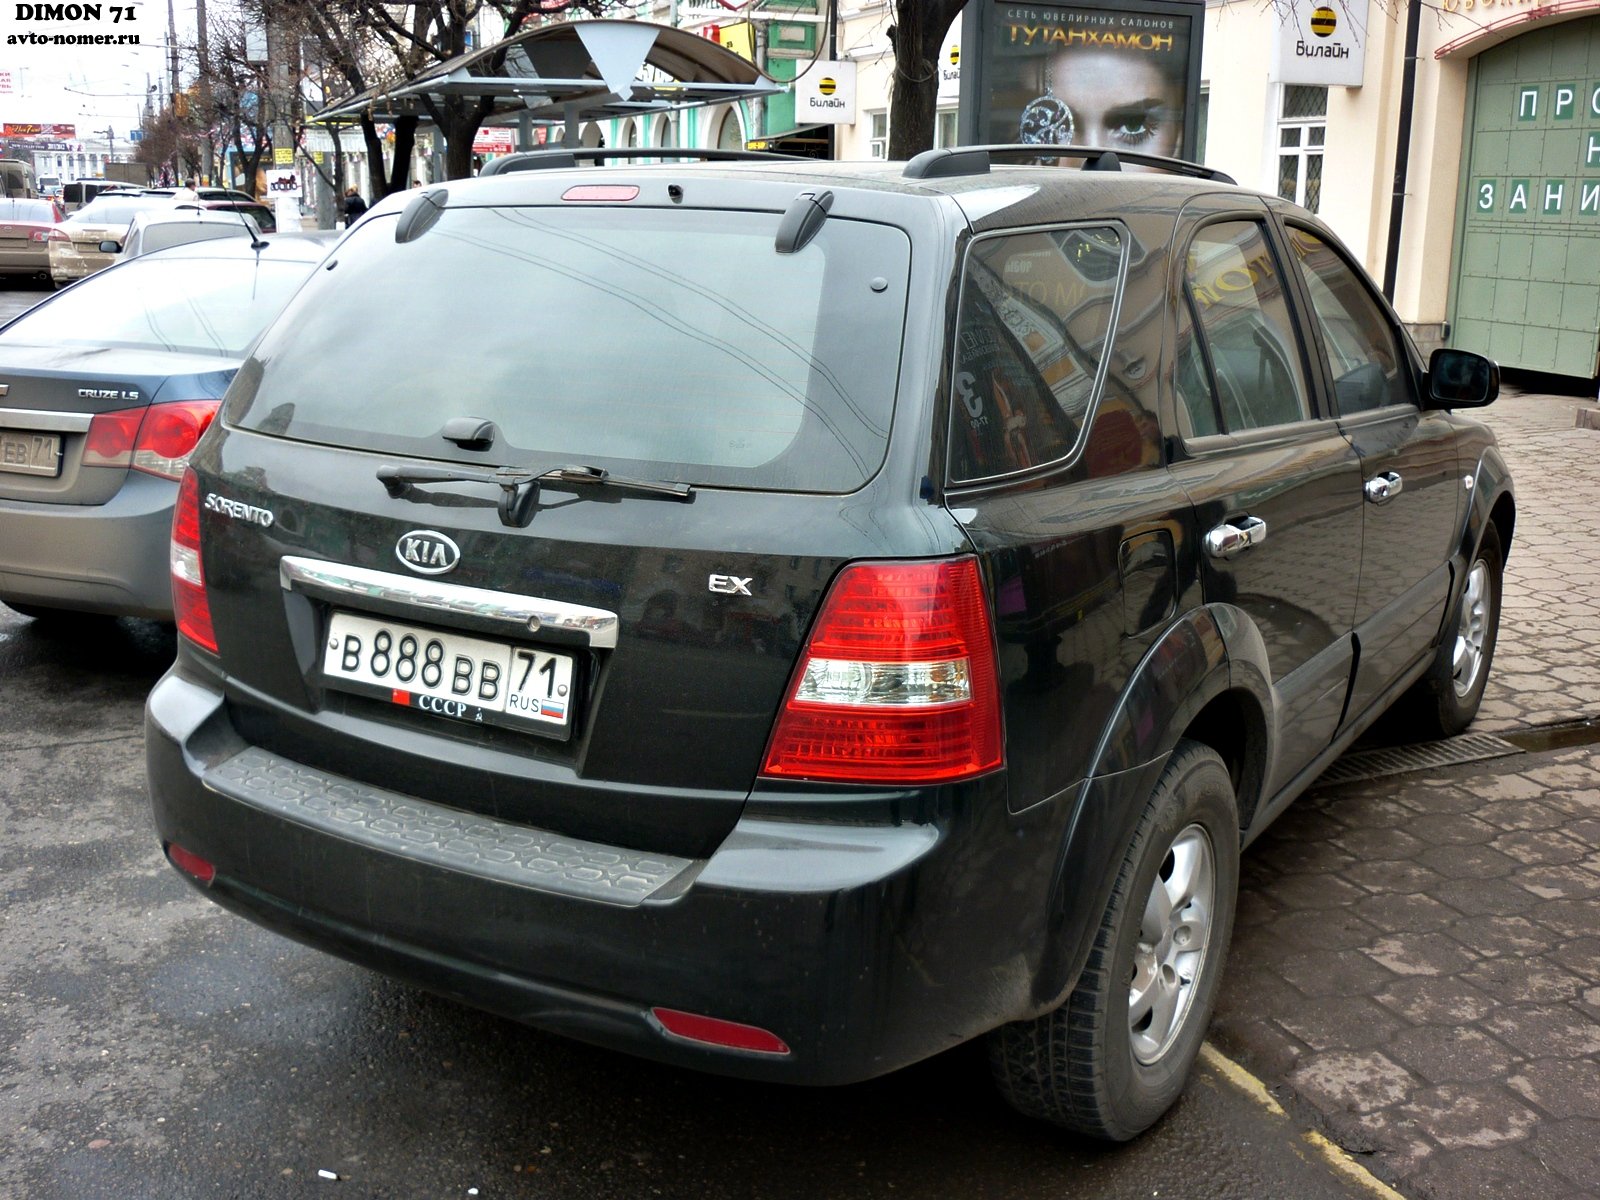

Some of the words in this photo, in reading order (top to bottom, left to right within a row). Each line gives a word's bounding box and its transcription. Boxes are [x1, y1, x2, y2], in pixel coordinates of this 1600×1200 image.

[1007, 9, 1037, 20] СЕТЬ
[1043, 12, 1115, 26] ЮВЕЛИРНЫХ
[1120, 17, 1174, 29] САЛОНОВ
[1007, 24, 1174, 52] ТУТАНХАМОН
[1296, 40, 1349, 59] Билайн
[810, 97, 846, 109] Билайн
[1479, 183, 1600, 211] ЗАНИ
[78, 388, 119, 399] CRUZE
[121, 390, 139, 400] LS
[33, 436, 54, 461] 71
[204, 492, 273, 528] SORENTO
[405, 537, 448, 567] KIA
[709, 573, 753, 597] EX
[516, 650, 557, 700] 71
[418, 694, 467, 718] СССР
[509, 693, 540, 714] RUS
